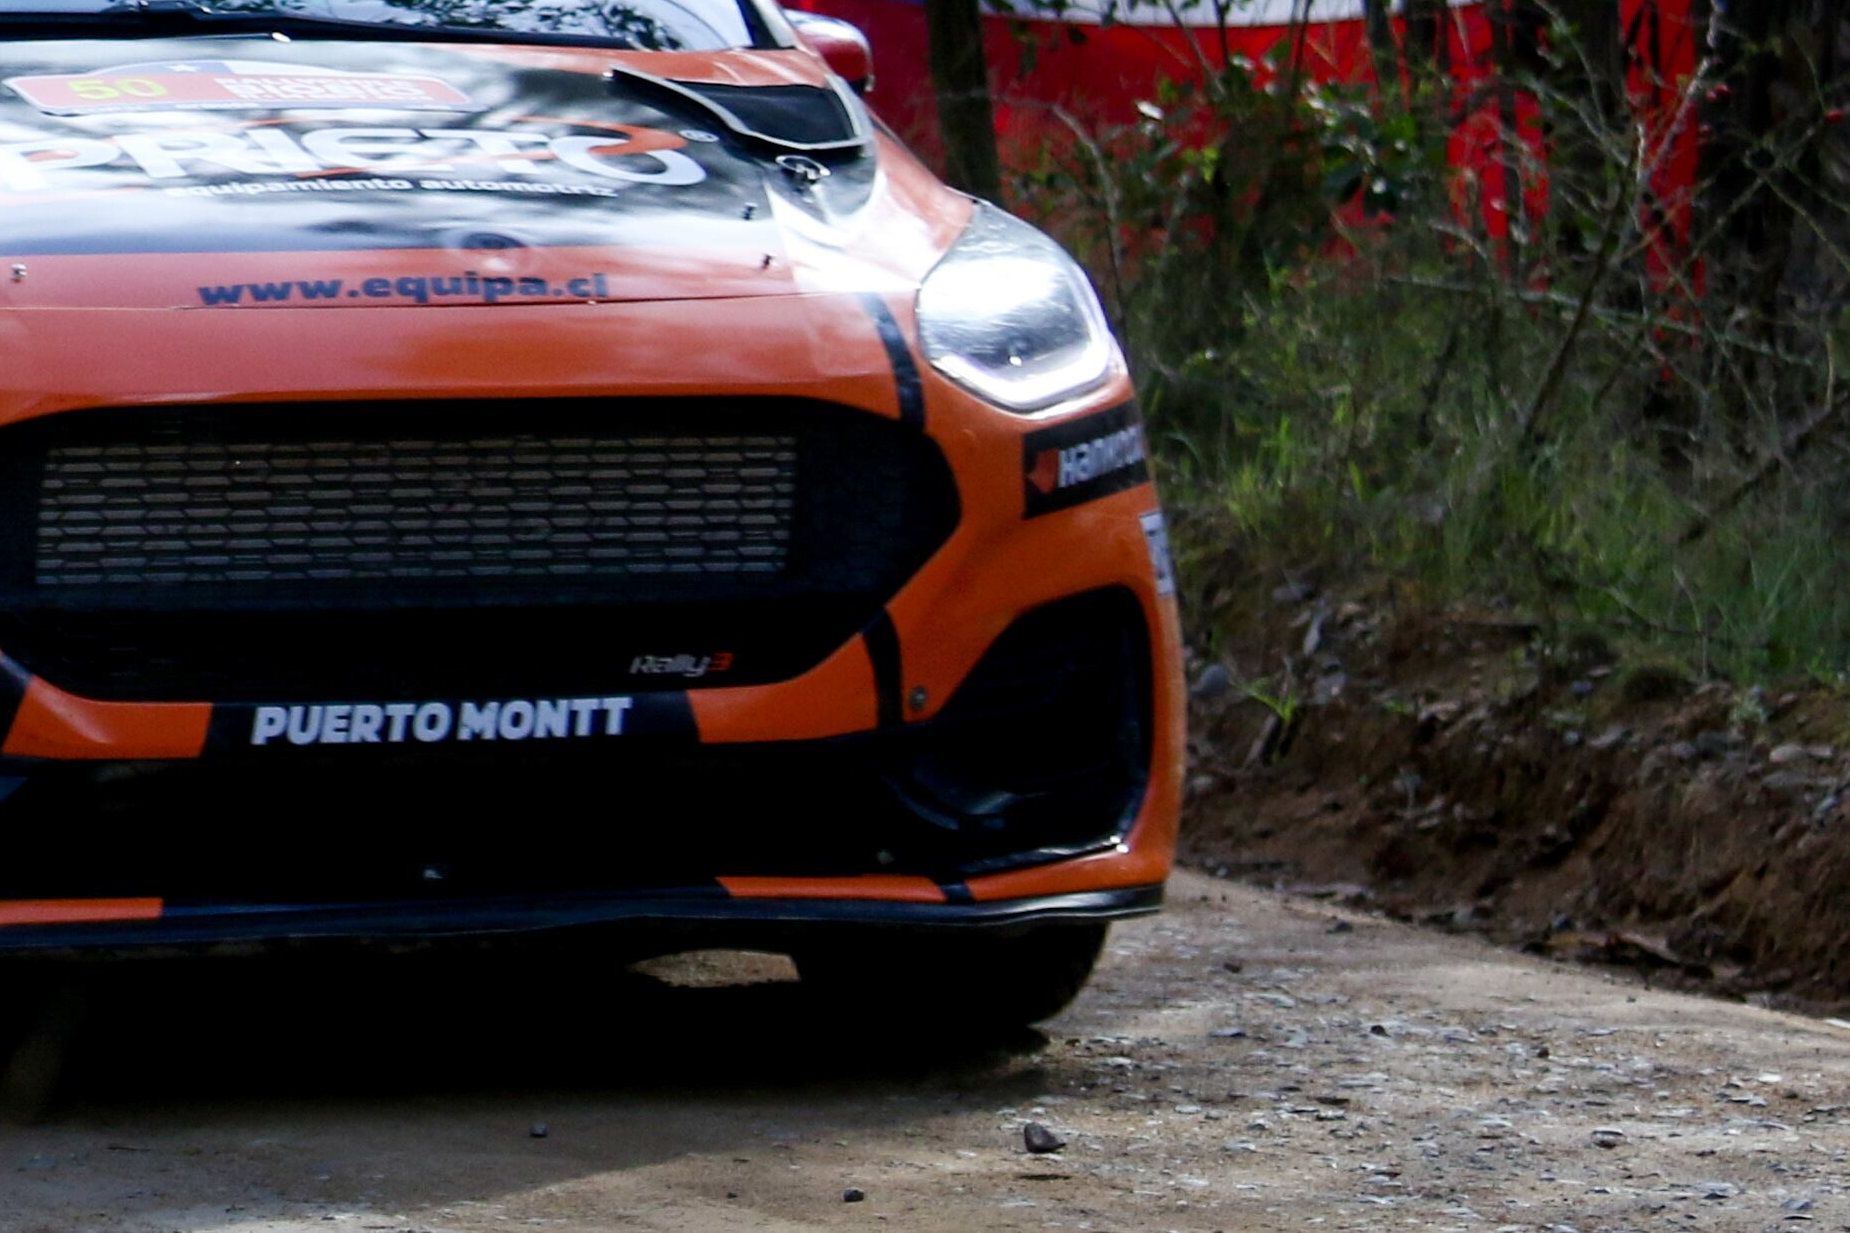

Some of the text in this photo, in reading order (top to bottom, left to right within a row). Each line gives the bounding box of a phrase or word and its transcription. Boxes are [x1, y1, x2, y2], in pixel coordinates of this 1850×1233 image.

[68, 78, 168, 101] 50
[163, 177, 618, 198] equipamiento automotriz
[197, 270, 609, 305] www.equipa.cl
[251, 697, 633, 746] PUERTO MONTT
